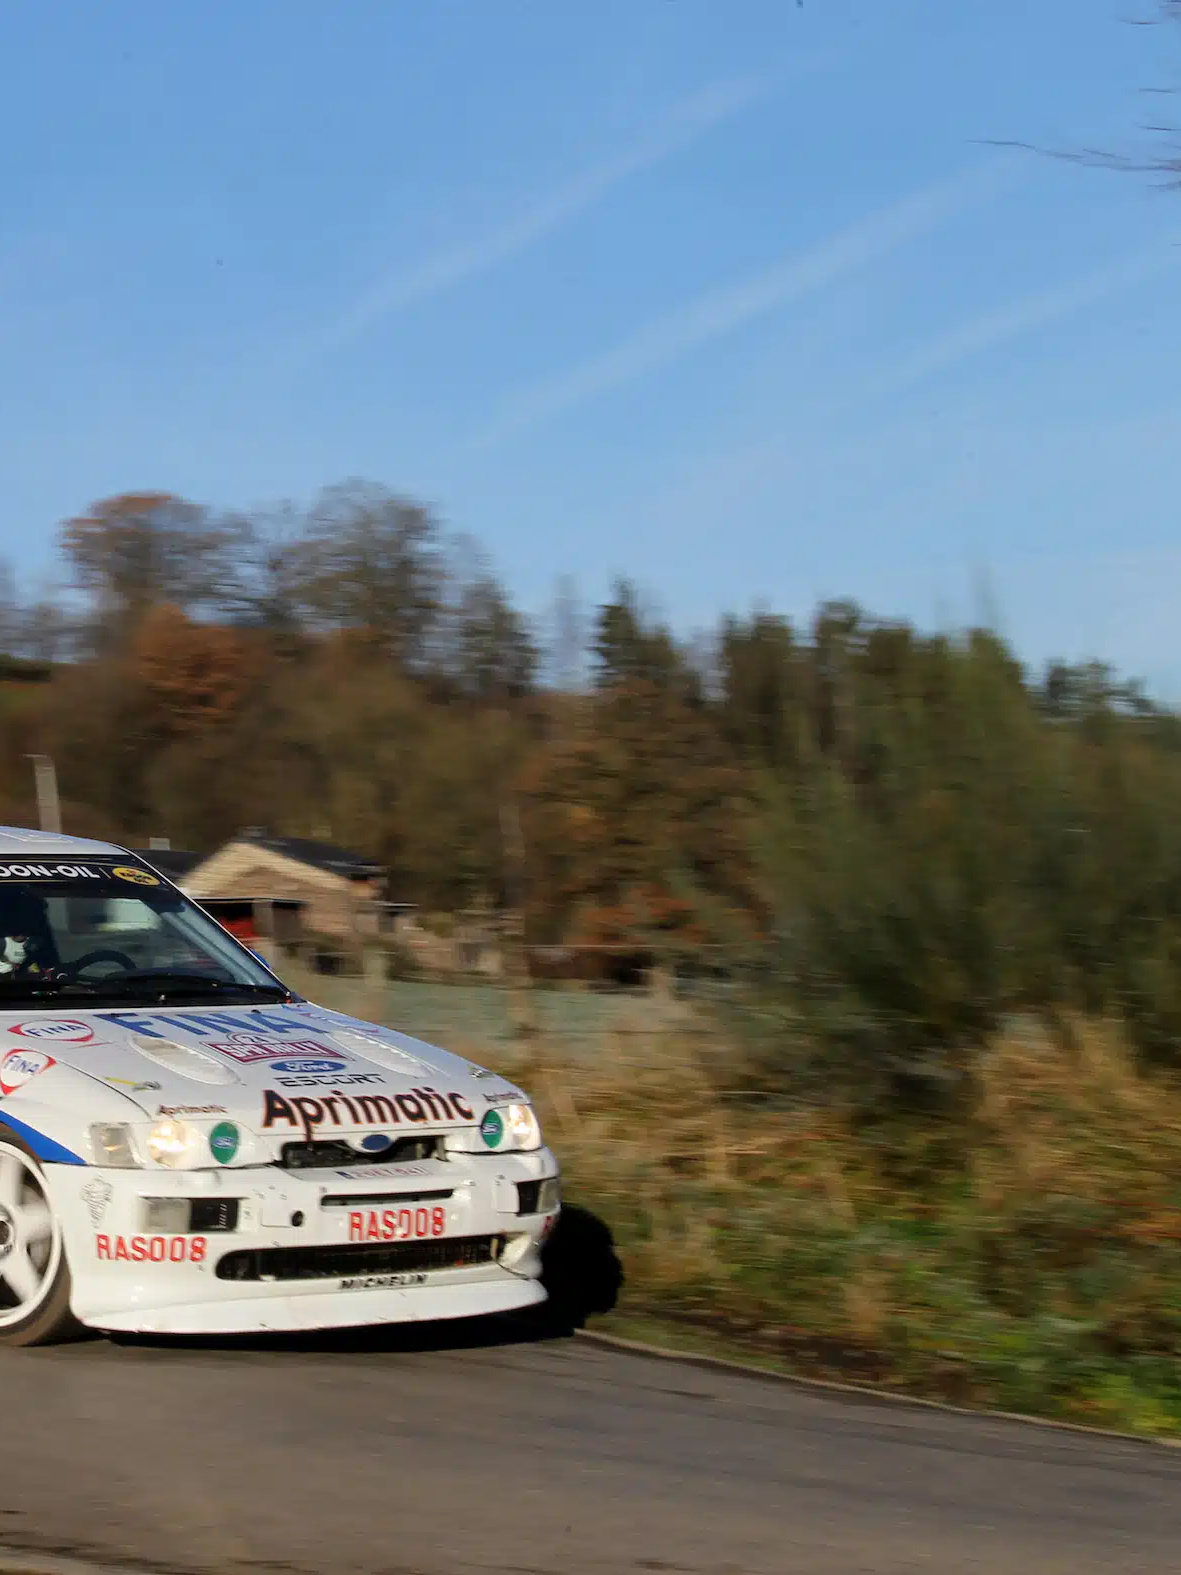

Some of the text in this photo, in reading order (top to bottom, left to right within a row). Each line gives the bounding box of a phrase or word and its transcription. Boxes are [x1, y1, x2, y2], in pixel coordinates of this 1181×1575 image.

[24, 1023, 88, 1037] FINA
[92, 1012, 329, 1038] FINA
[4, 1055, 40, 1076] FINA
[275, 1073, 388, 1088] ESCORT
[261, 1086, 476, 1141] Aprimatic
[339, 1274, 428, 1289] MICHELIN
